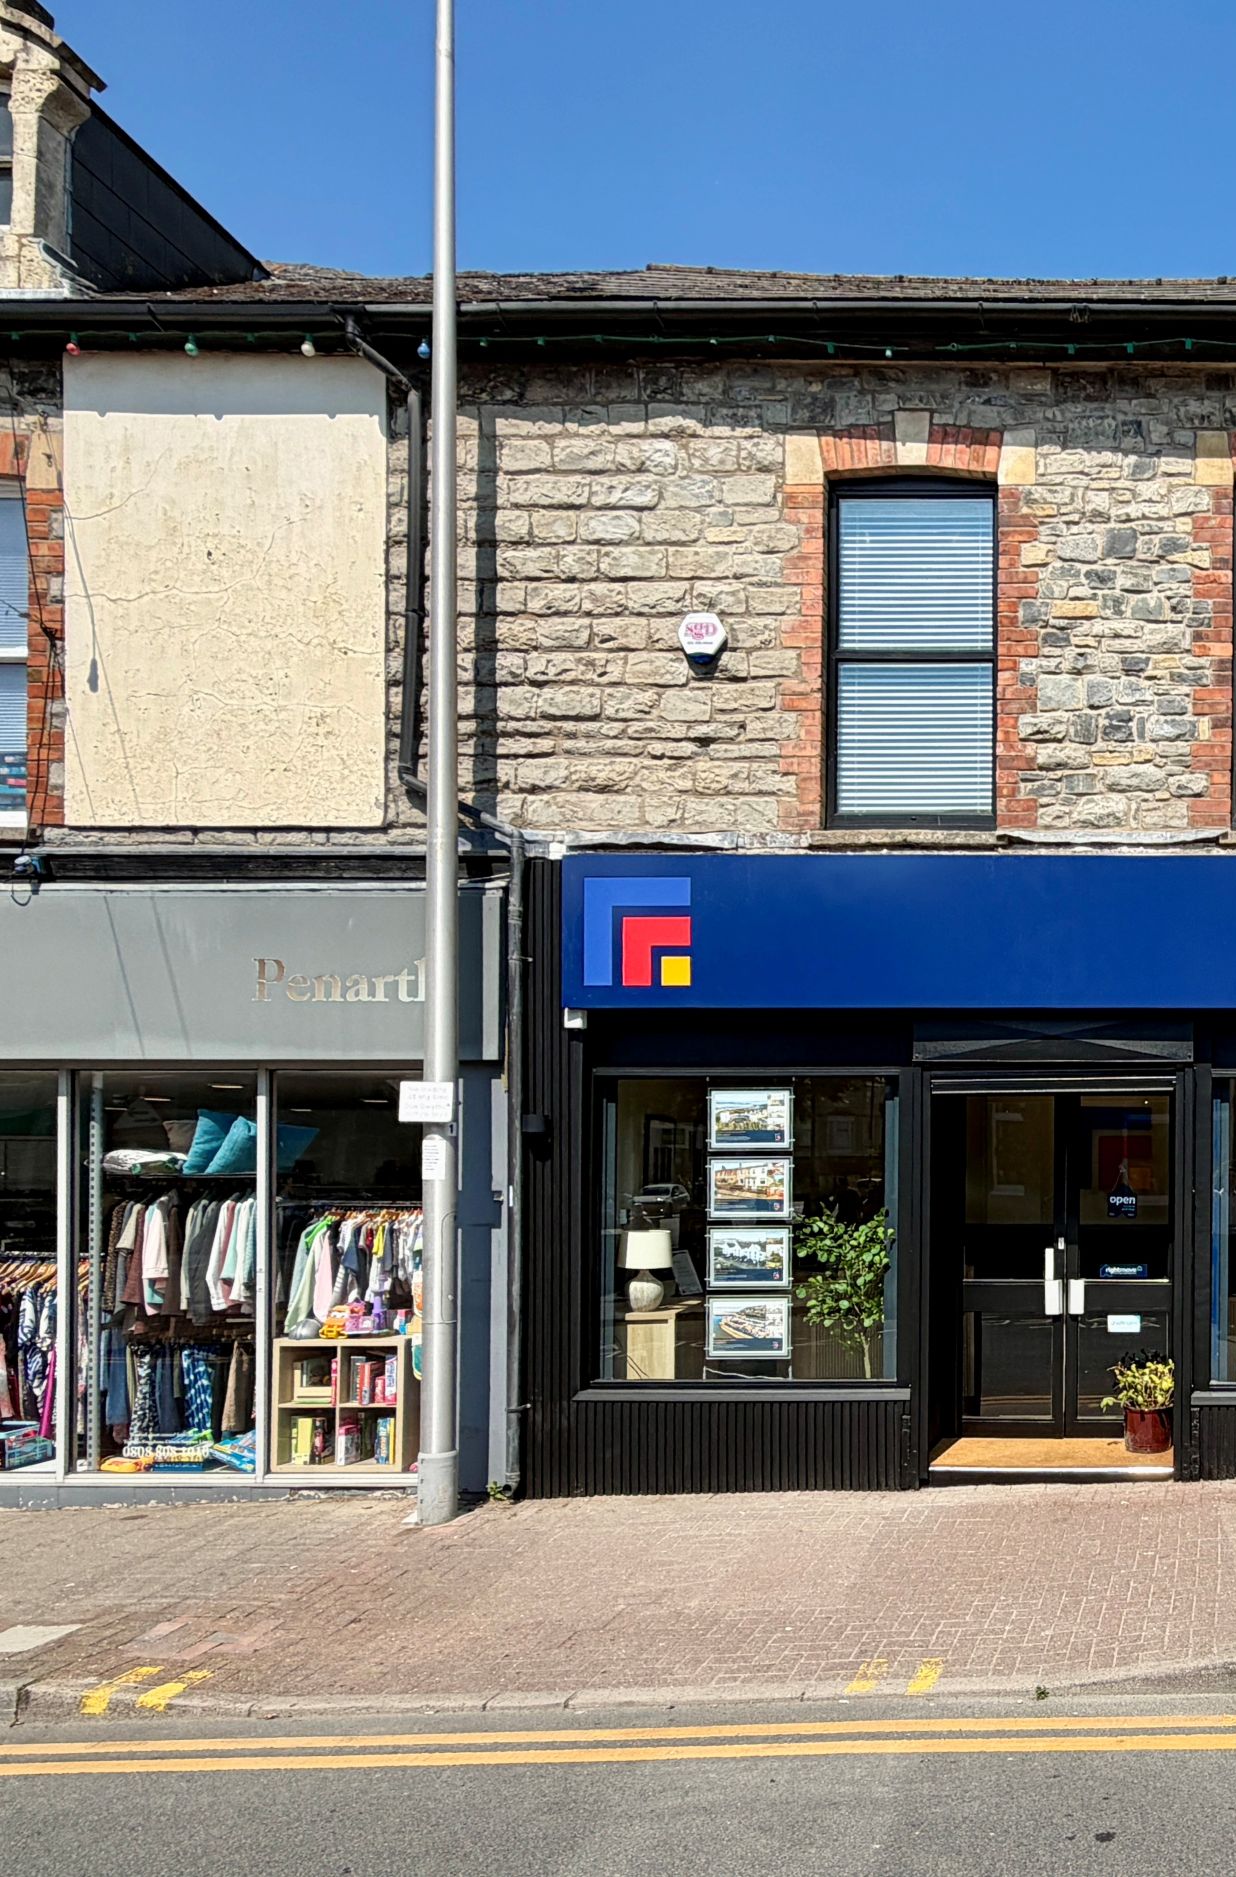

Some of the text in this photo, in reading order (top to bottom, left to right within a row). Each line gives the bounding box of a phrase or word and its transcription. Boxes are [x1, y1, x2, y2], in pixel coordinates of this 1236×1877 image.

[1109, 1196, 1136, 1206] open
[1105, 1266, 1138, 1275] rightmove
[122, 1445, 152, 1458] 0808
